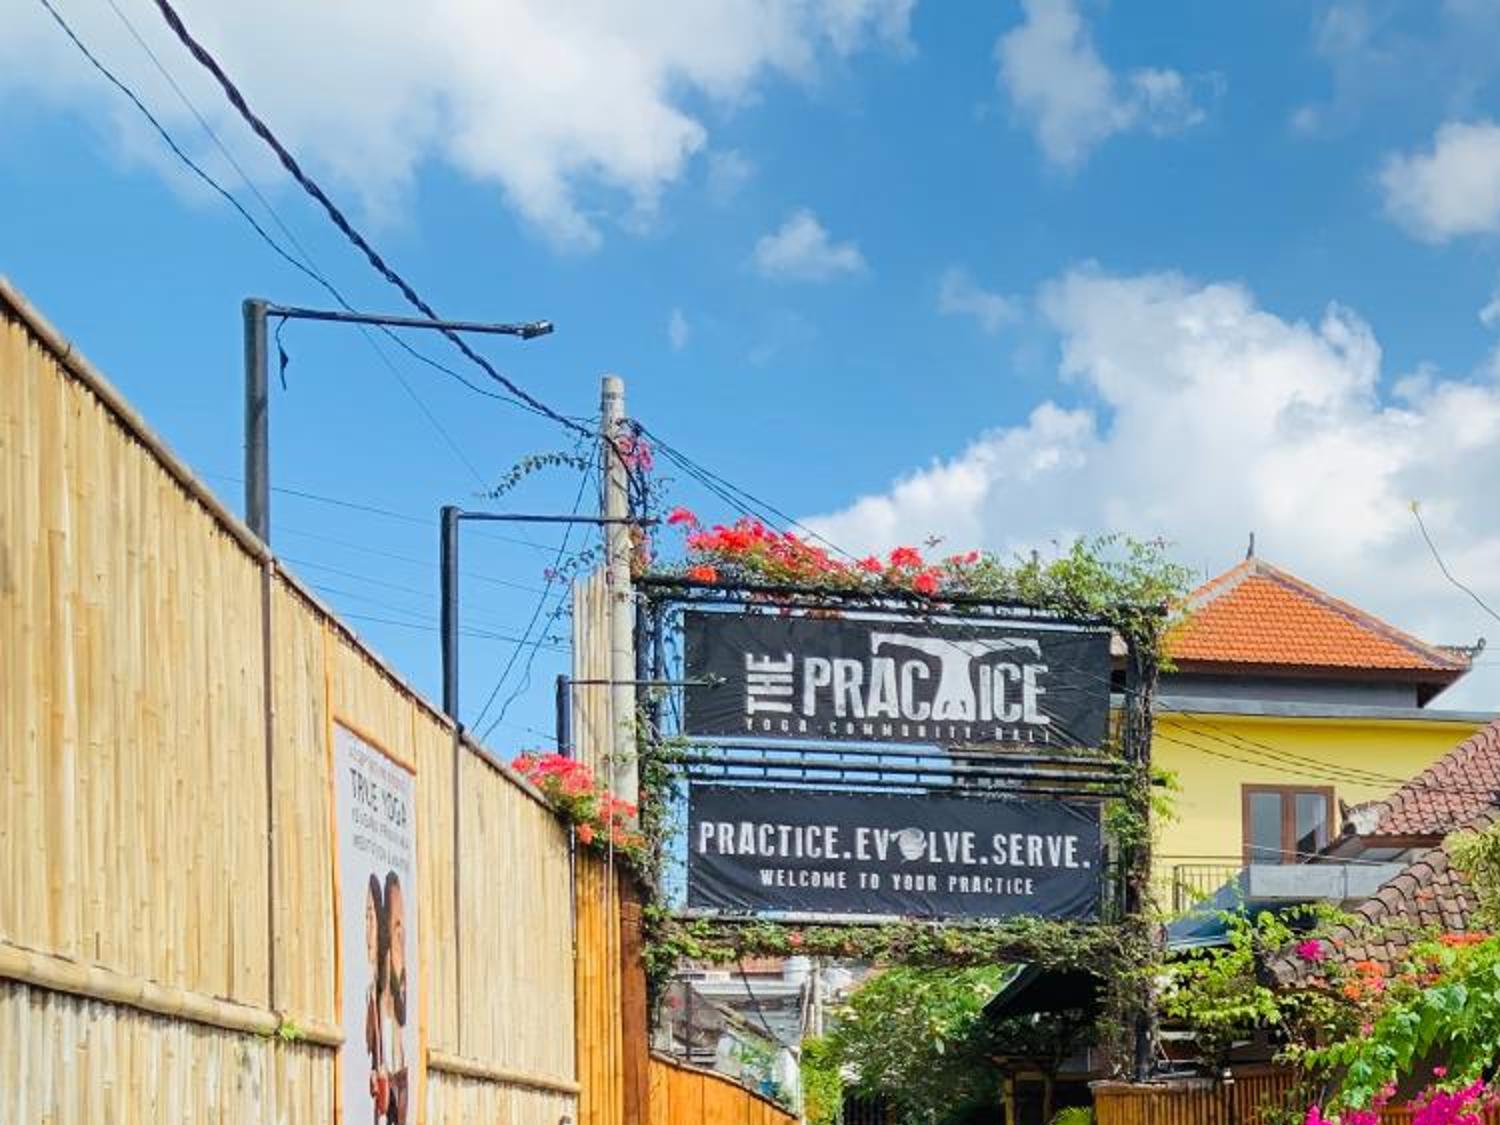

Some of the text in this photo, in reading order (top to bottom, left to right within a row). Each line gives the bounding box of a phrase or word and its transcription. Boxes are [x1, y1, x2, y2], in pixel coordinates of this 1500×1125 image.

[745, 631, 1051, 725] THE PRACTICE
[760, 868, 1034, 895] WELCOME TO YOUR PRACTICE
